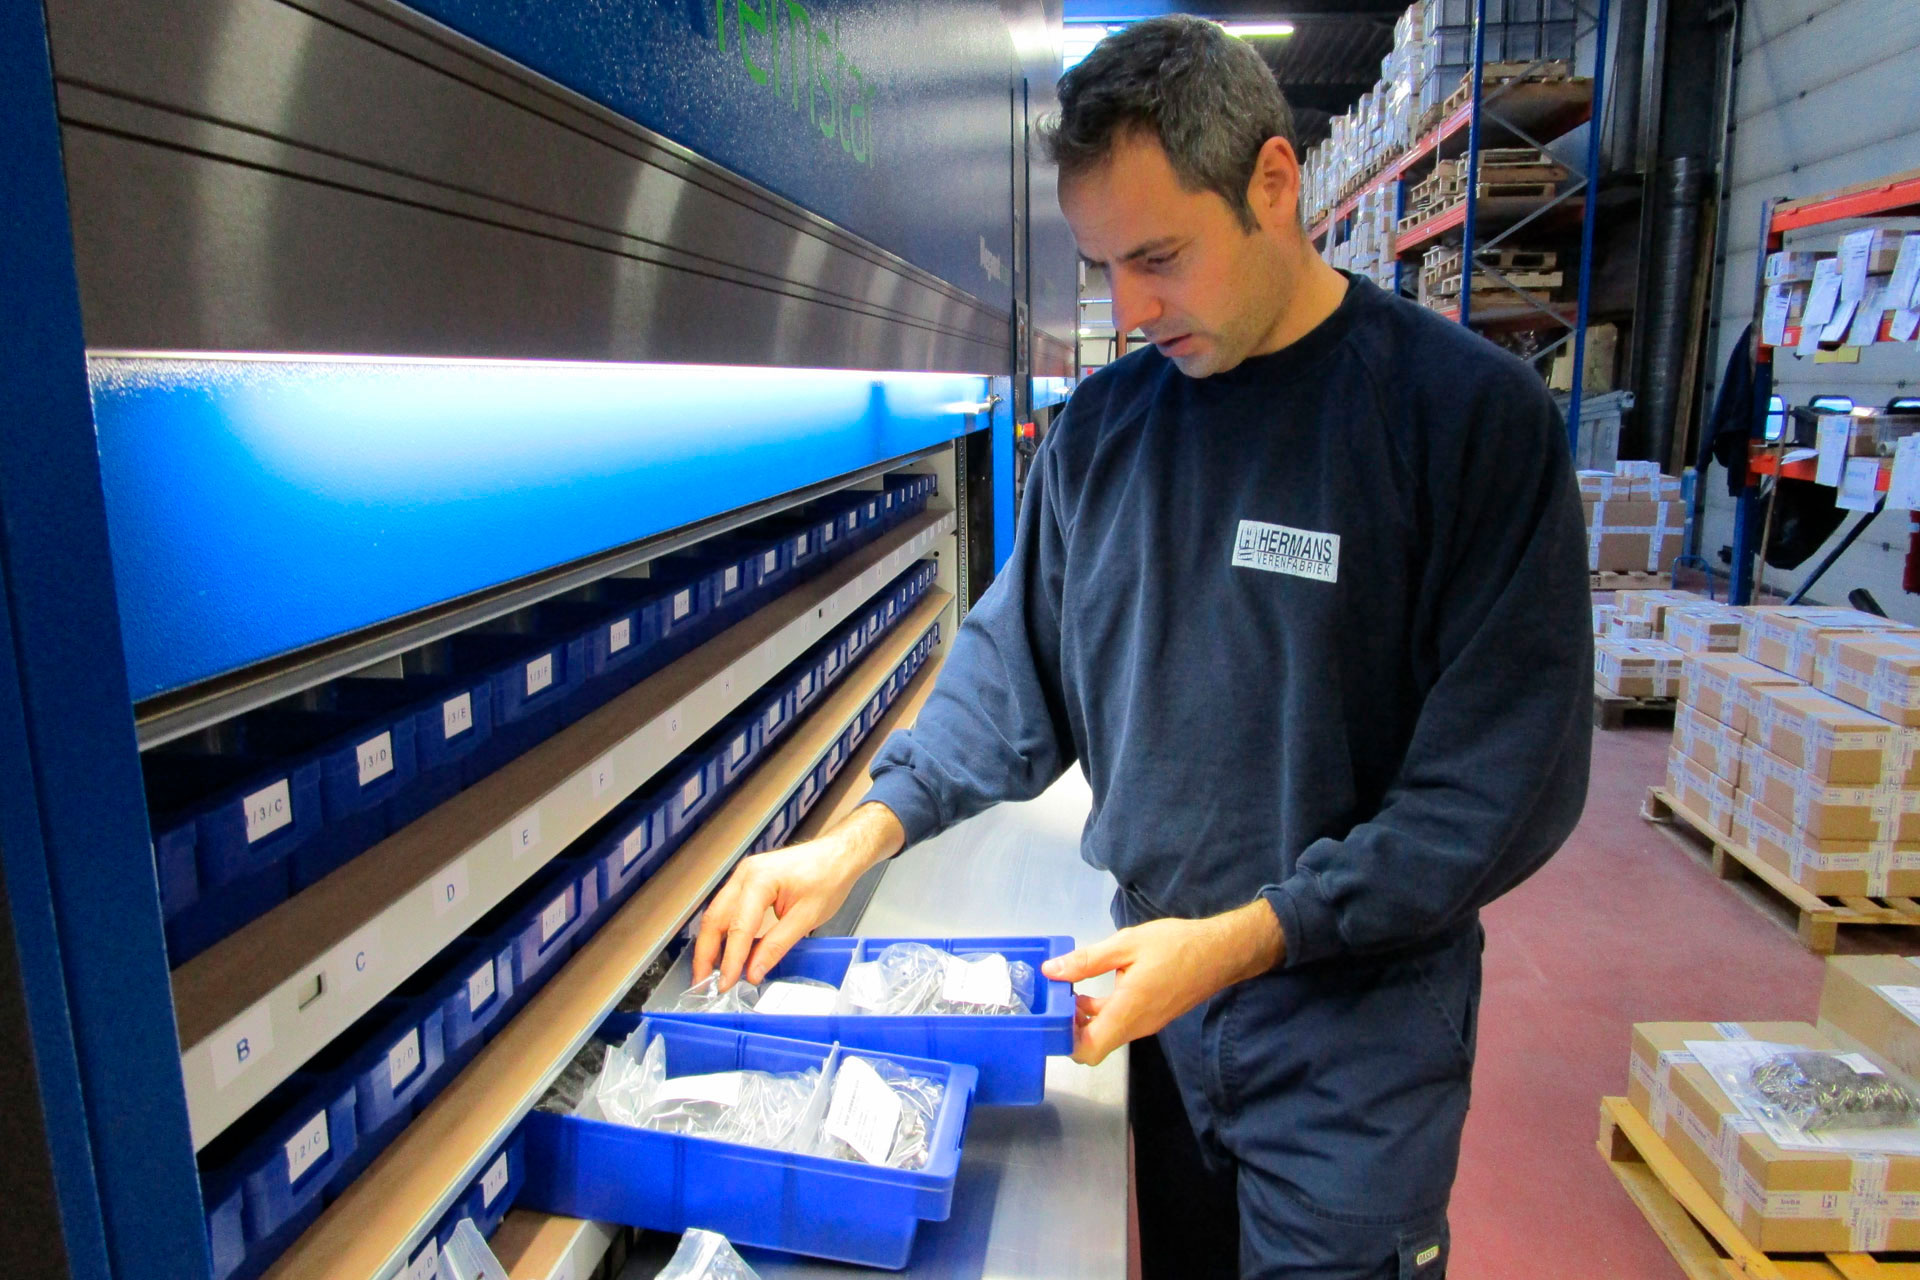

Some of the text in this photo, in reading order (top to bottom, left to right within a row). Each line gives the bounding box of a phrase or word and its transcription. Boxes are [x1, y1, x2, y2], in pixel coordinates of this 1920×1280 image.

[1258, 528, 1333, 562] HERMANS
[1257, 552, 1331, 577] VERENFABRIEK
[522, 829, 529, 845] E
[446, 883, 455, 902] D
[355, 951, 367, 973] C
[235, 1037, 250, 1064] B
